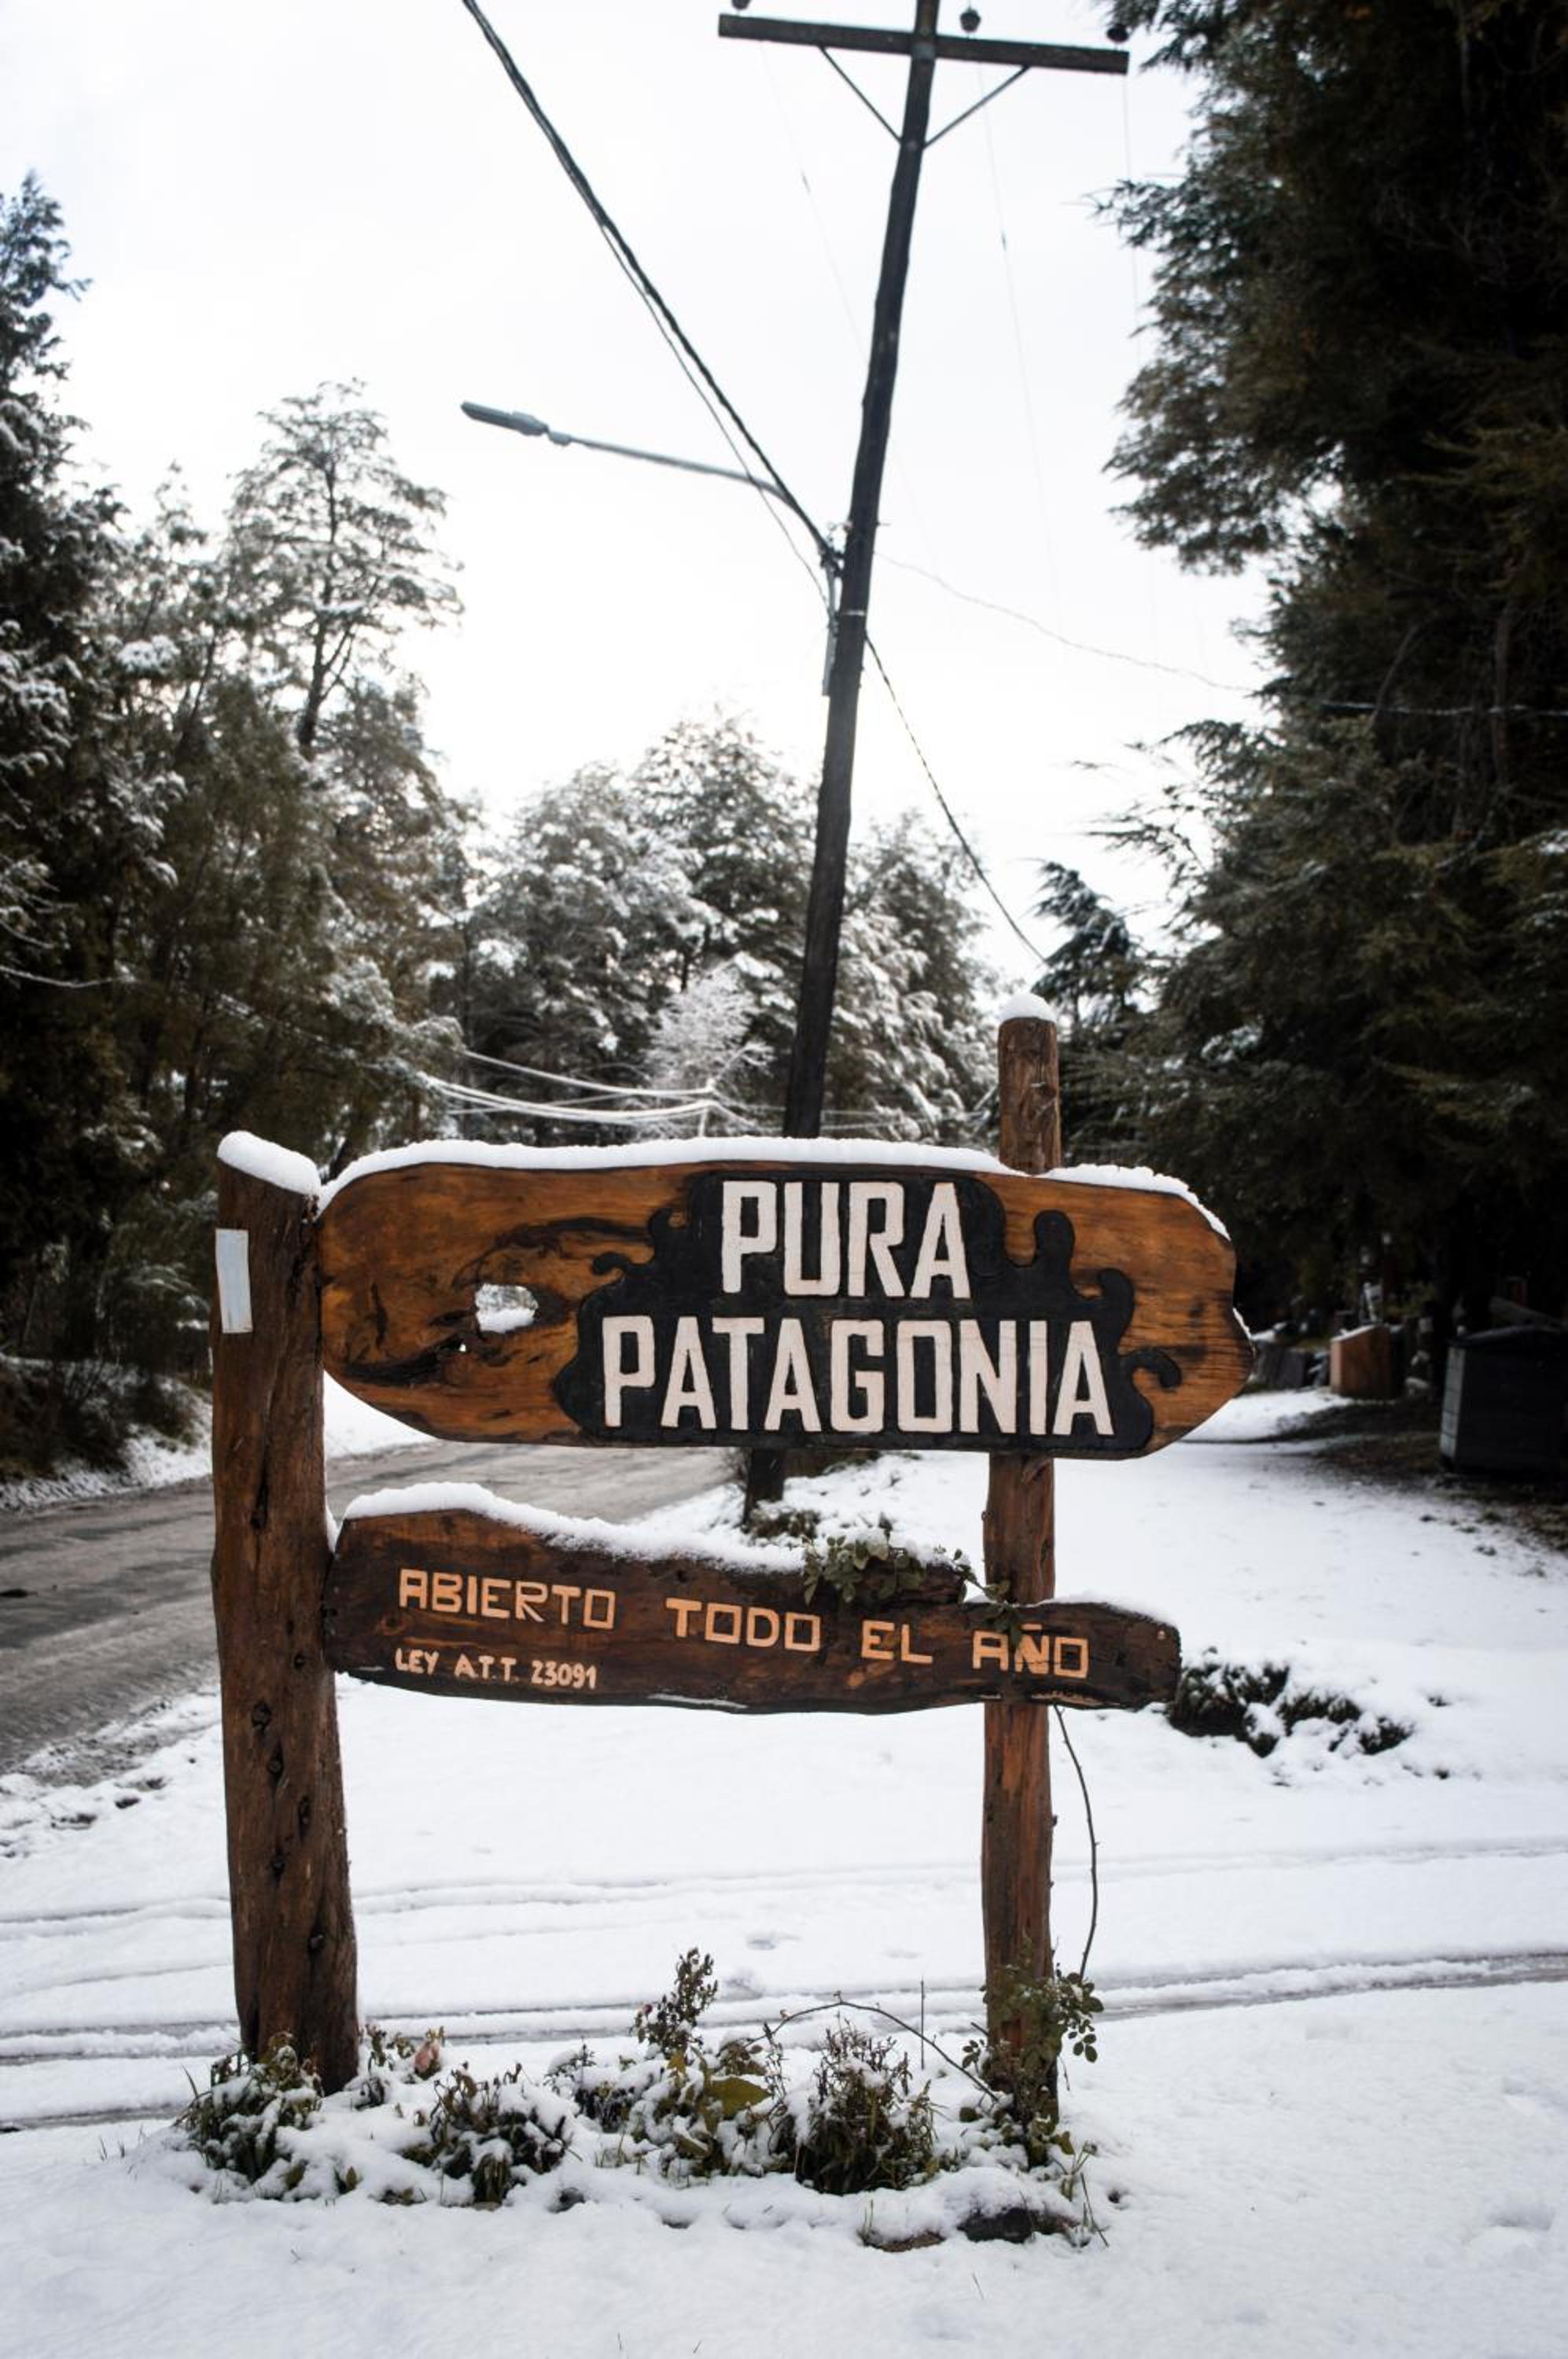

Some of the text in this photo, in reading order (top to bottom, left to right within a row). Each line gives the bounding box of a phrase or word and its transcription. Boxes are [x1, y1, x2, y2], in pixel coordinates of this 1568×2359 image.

[722, 1180, 971, 1299] PURA
[602, 1315, 1114, 1436] PATAGONIA
[395, 1648, 440, 1674] LEY
[532, 1660, 597, 1690] 23091
[399, 1569, 1089, 1679] ABIERTO TODO EL AÑO
